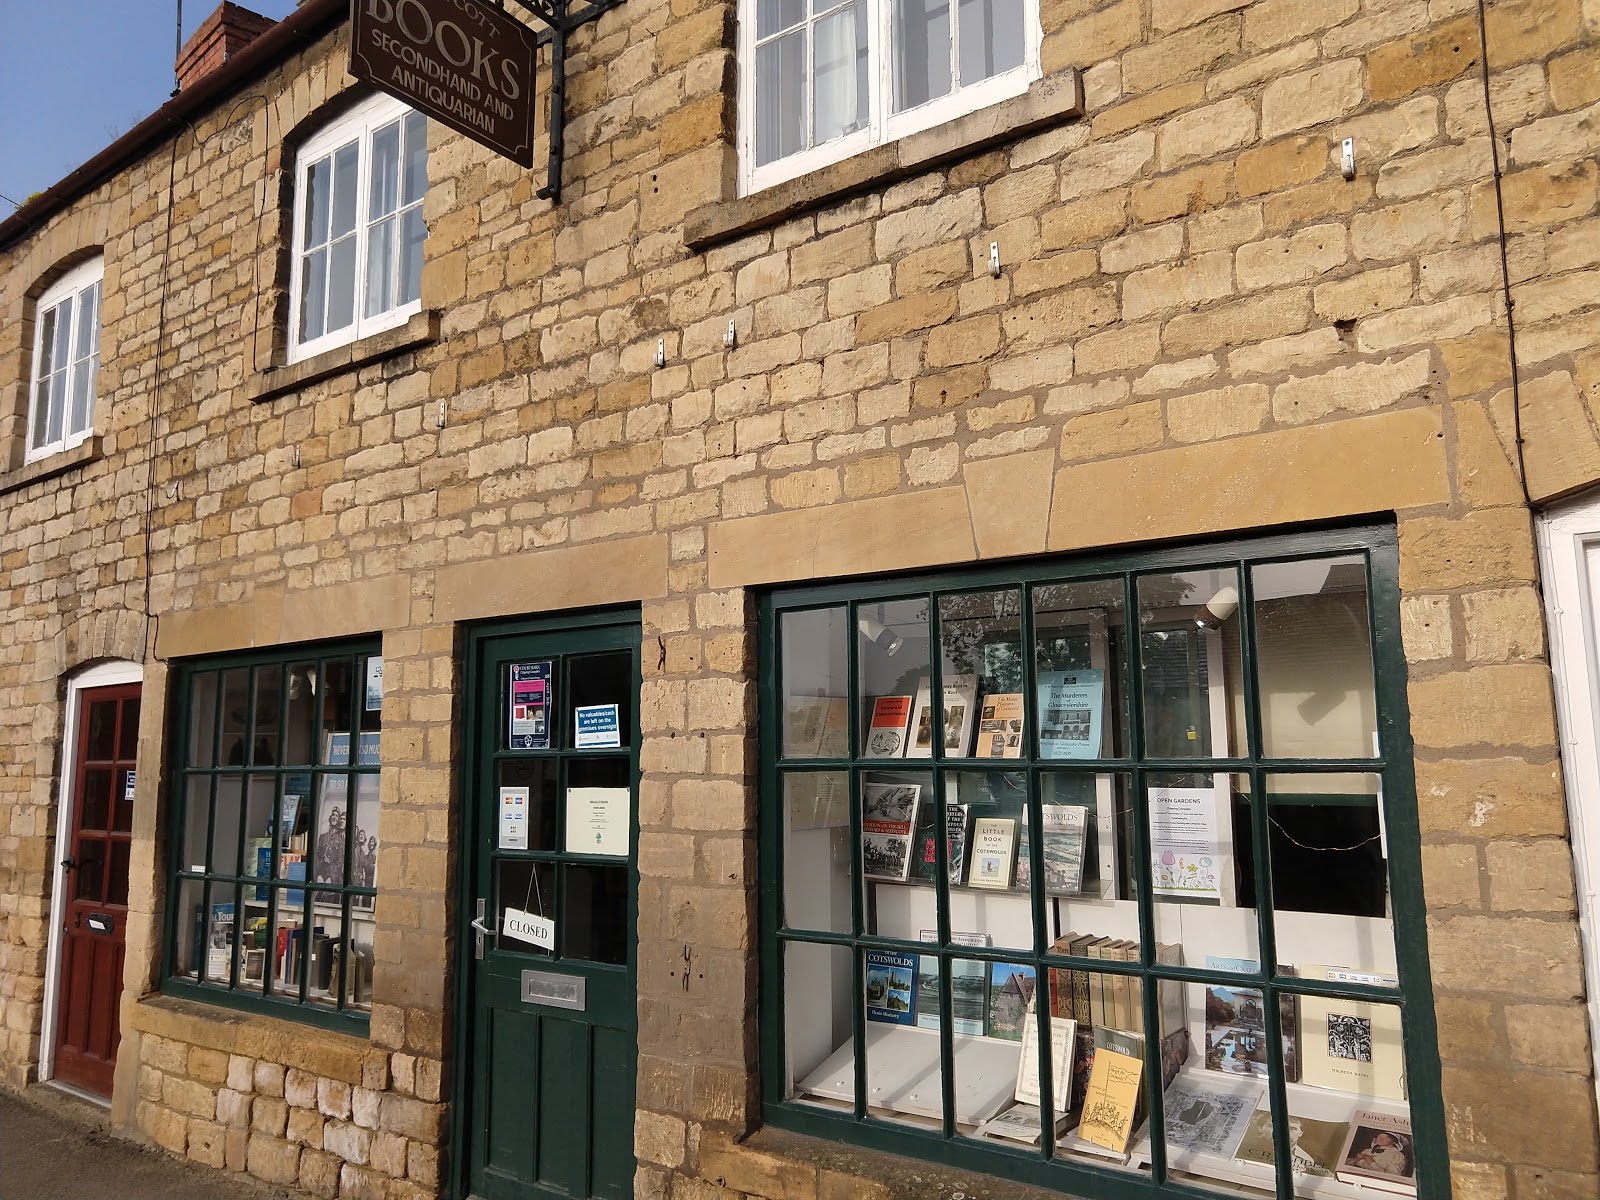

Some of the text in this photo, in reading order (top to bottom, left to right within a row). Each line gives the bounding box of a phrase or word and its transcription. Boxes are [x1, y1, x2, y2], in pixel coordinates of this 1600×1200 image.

[450, 0, 500, 39] COTT
[366, 0, 520, 100] BOOKS
[371, 28, 514, 121] SECONDHAND AND
[391, 64, 495, 135] ANTIQUARIAN
[586, 710, 615, 718] valuables/cash
[597, 723, 617, 731] overnight
[369, 743, 381, 755] MUC
[1043, 812, 1078, 821] SWOLDS
[509, 919, 548, 939] CLOSED
[868, 954, 914, 967] COTSWOLDS
[1361, 1112, 1387, 1122] Janet
